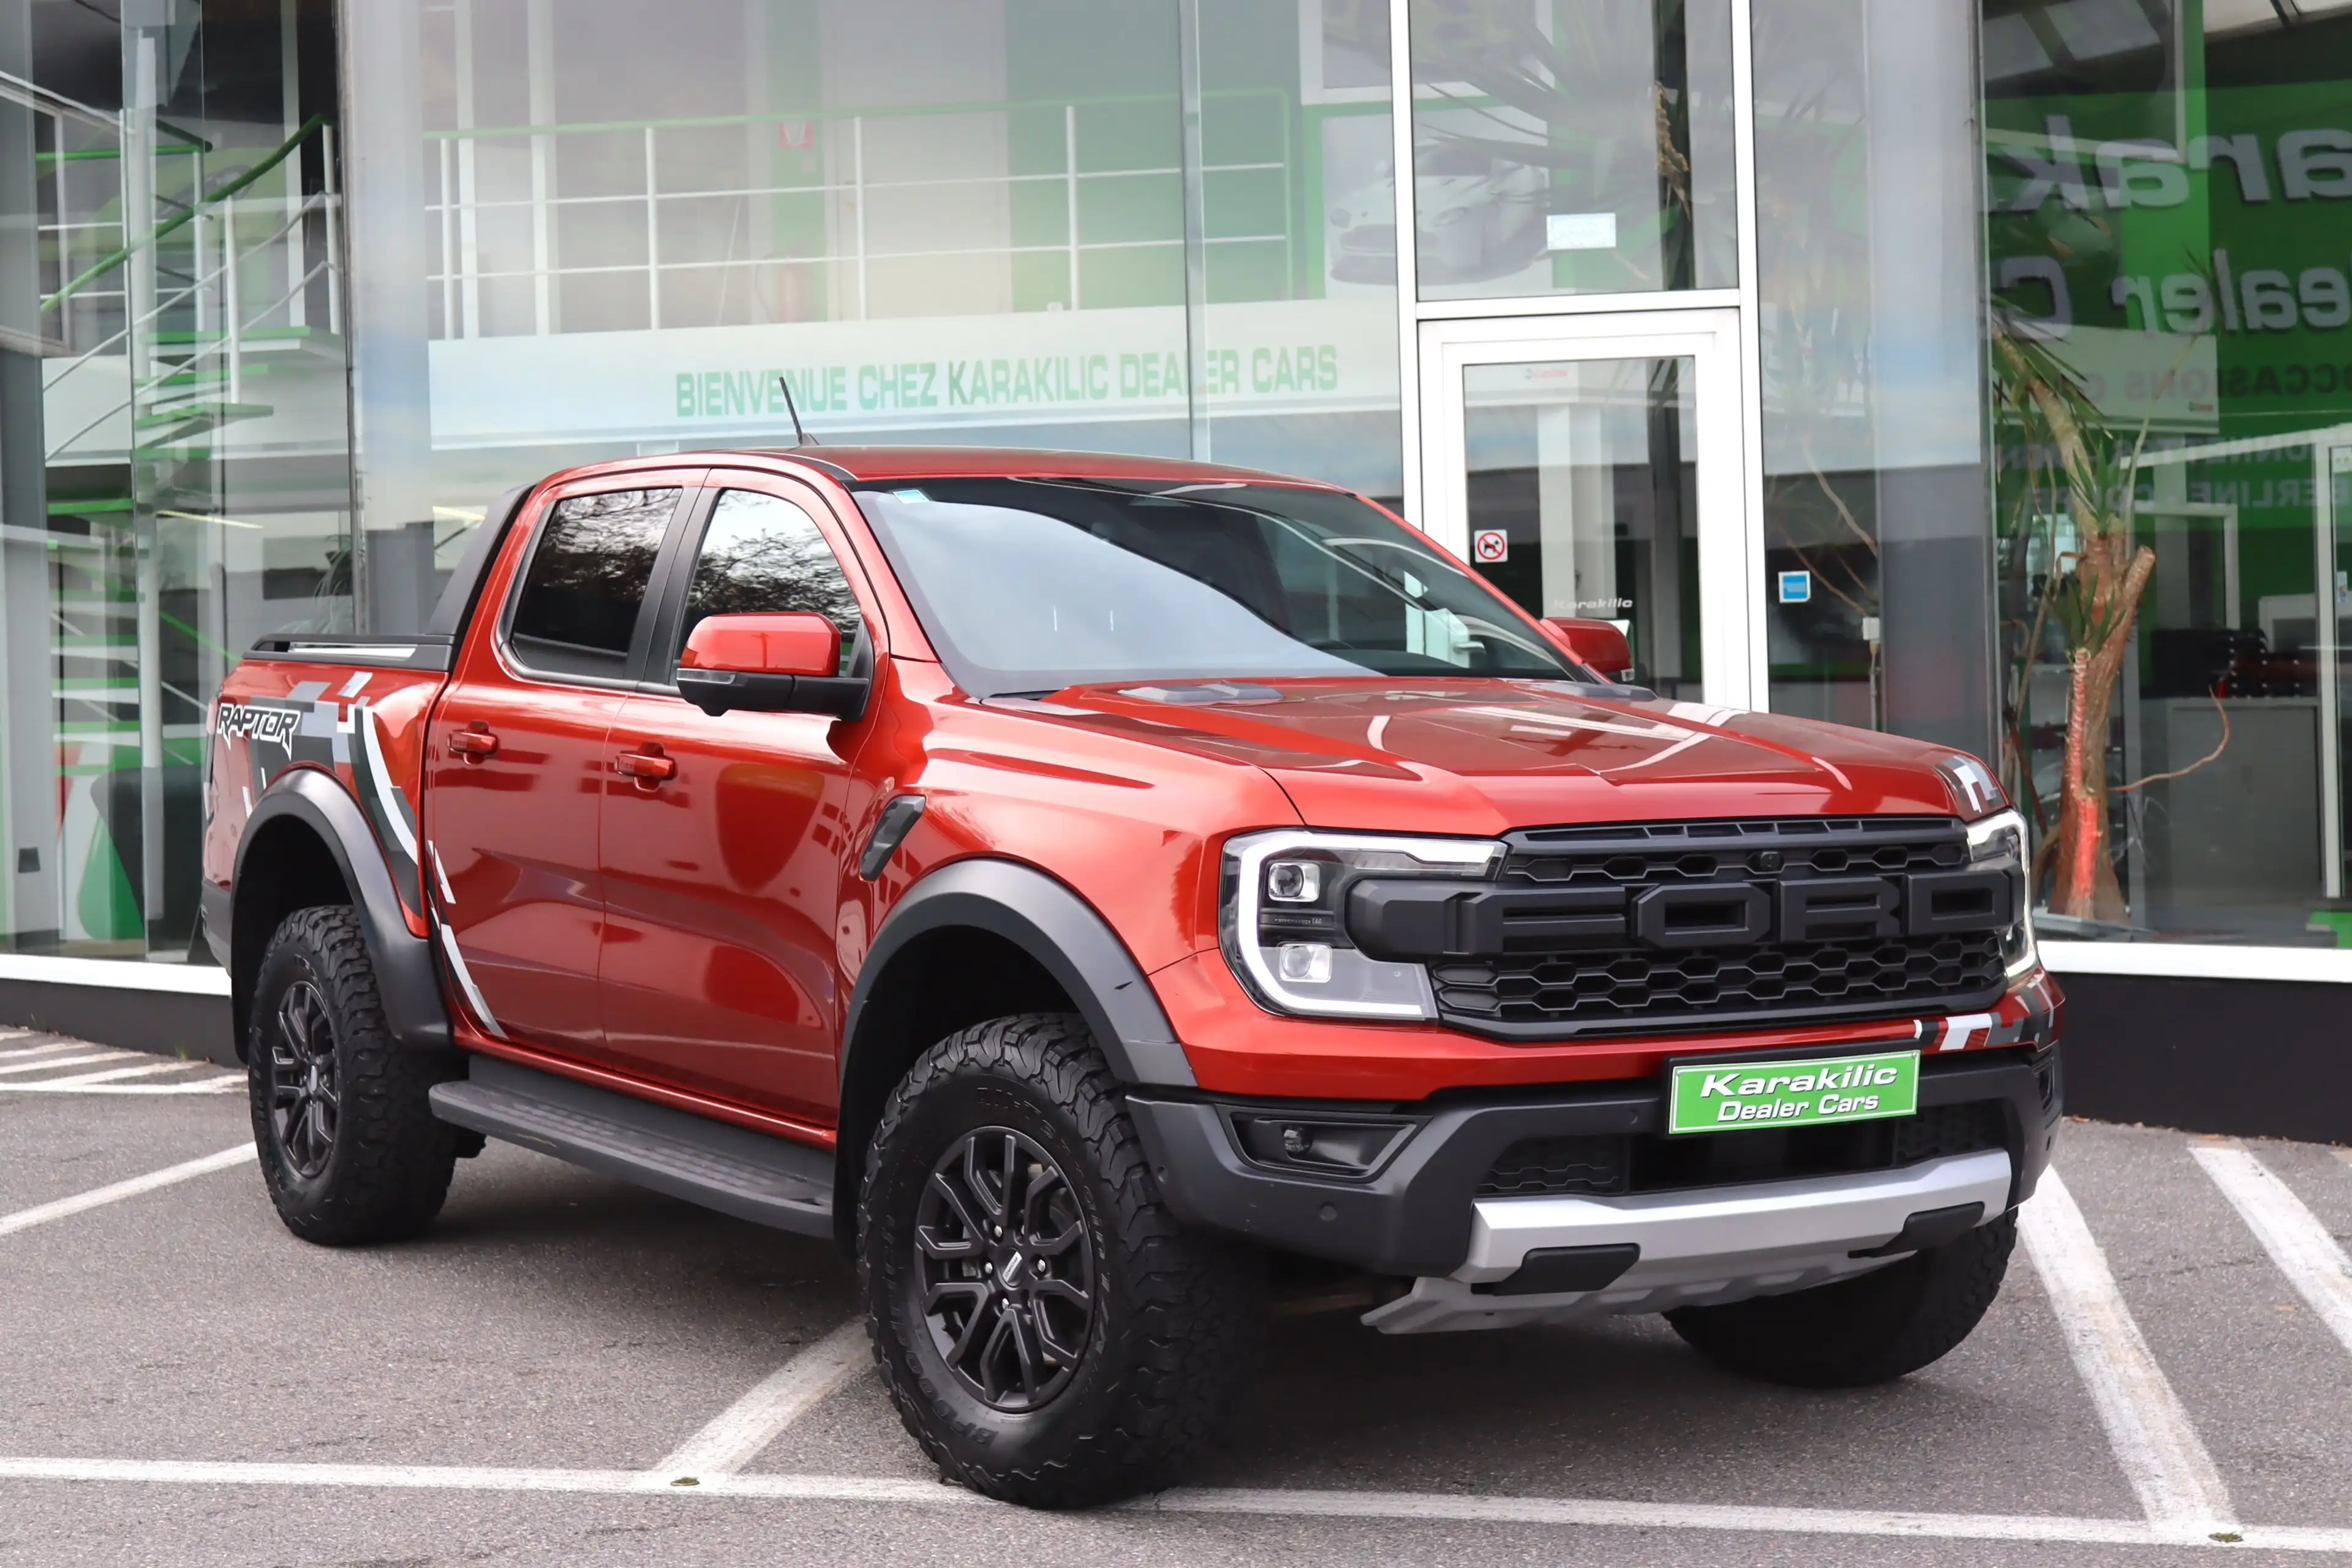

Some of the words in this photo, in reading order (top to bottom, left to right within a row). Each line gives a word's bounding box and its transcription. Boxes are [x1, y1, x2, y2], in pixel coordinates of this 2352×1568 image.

[676, 366, 847, 418] BIENVENUE
[858, 361, 938, 410] CHEZ
[947, 353, 1109, 405] KARAKILIC
[1251, 344, 1338, 394] CARS
[1553, 598, 1633, 609] Karakilic
[216, 703, 301, 761] RAPTOR
[1457, 864, 2022, 954] FORD
[1700, 1064, 1898, 1098] Karakilic
[1717, 1099, 1809, 1121] Dealer
[1818, 1094, 1879, 1115] Cars
